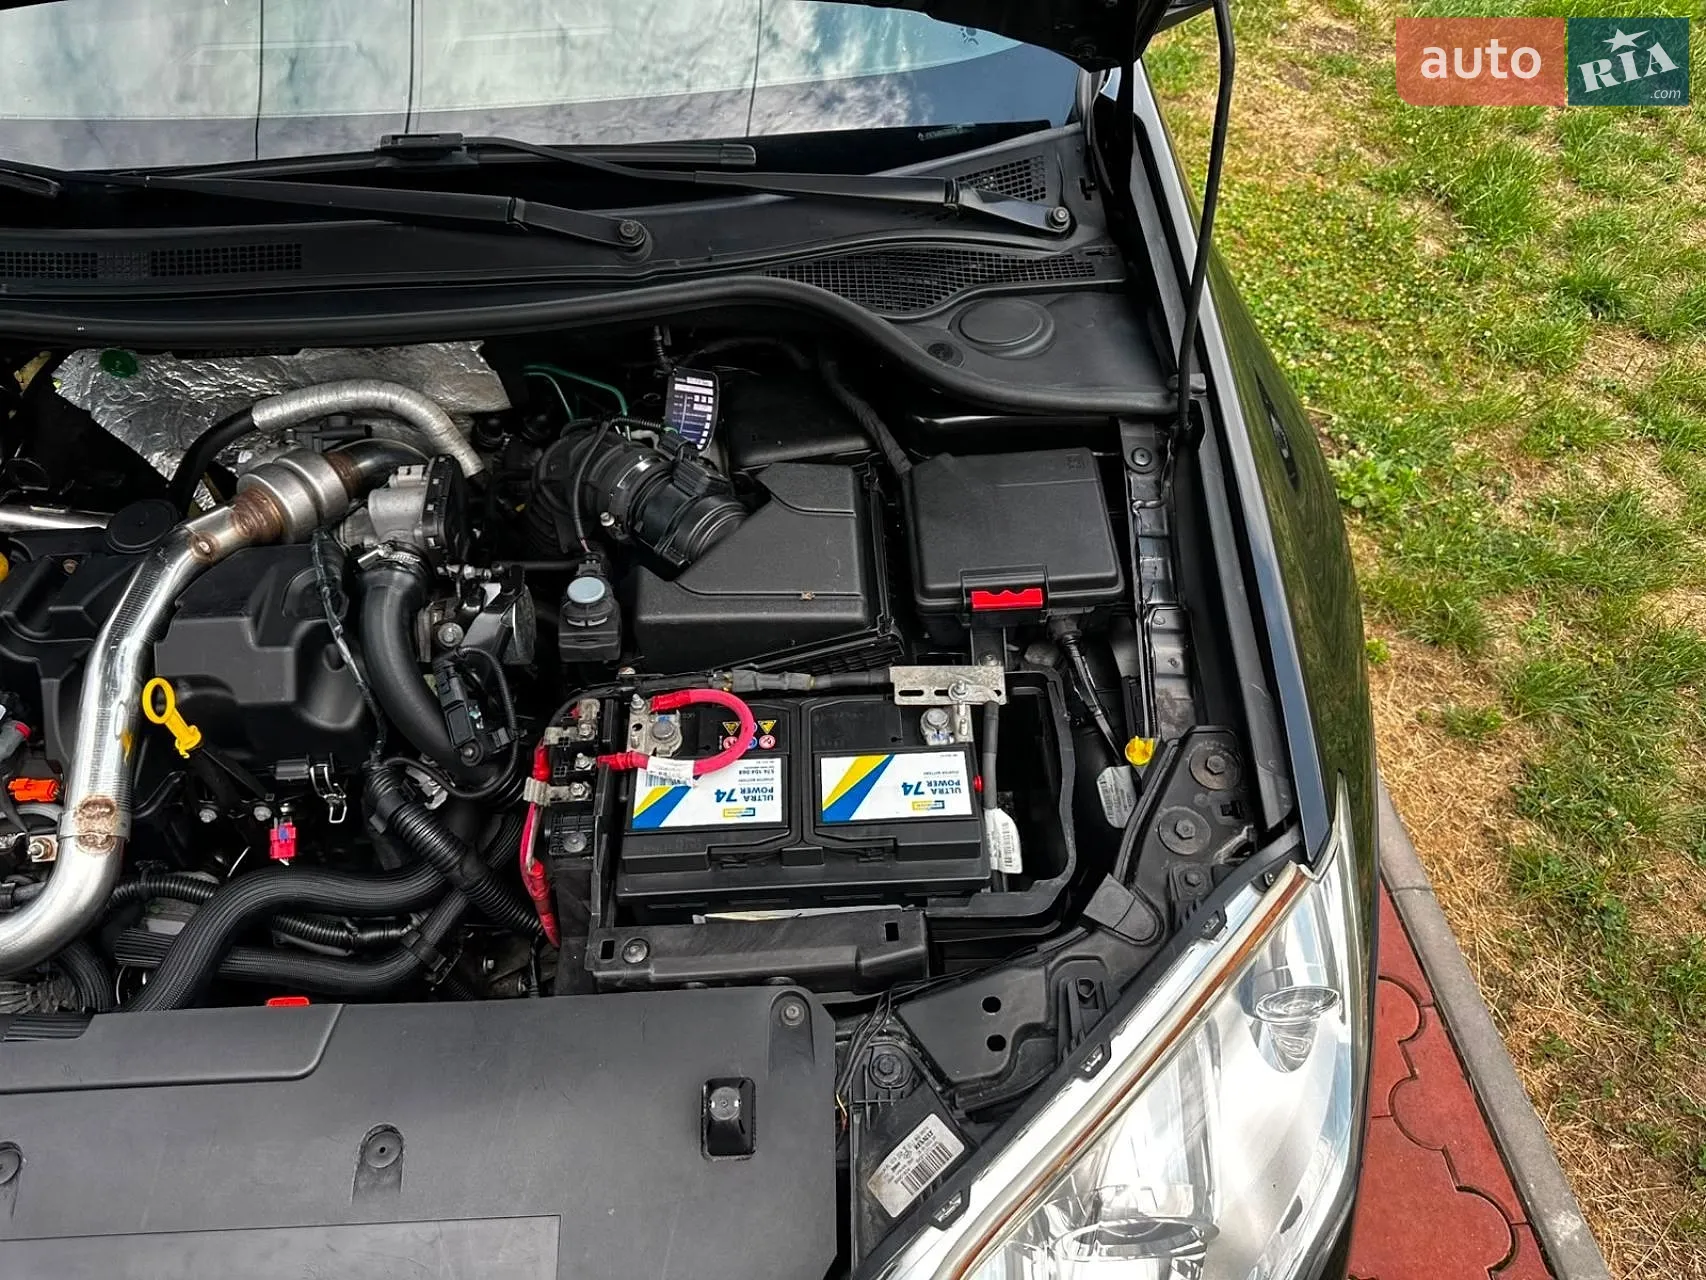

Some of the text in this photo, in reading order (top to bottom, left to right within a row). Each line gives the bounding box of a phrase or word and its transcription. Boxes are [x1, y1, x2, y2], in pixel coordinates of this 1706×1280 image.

[926, 779, 961, 787] POWER
[740, 787, 774, 795] POWER
[901, 781, 925, 796] 74
[930, 787, 962, 795] ULTRA
[714, 788, 738, 803] 74
[743, 794, 774, 802] ULTRA
